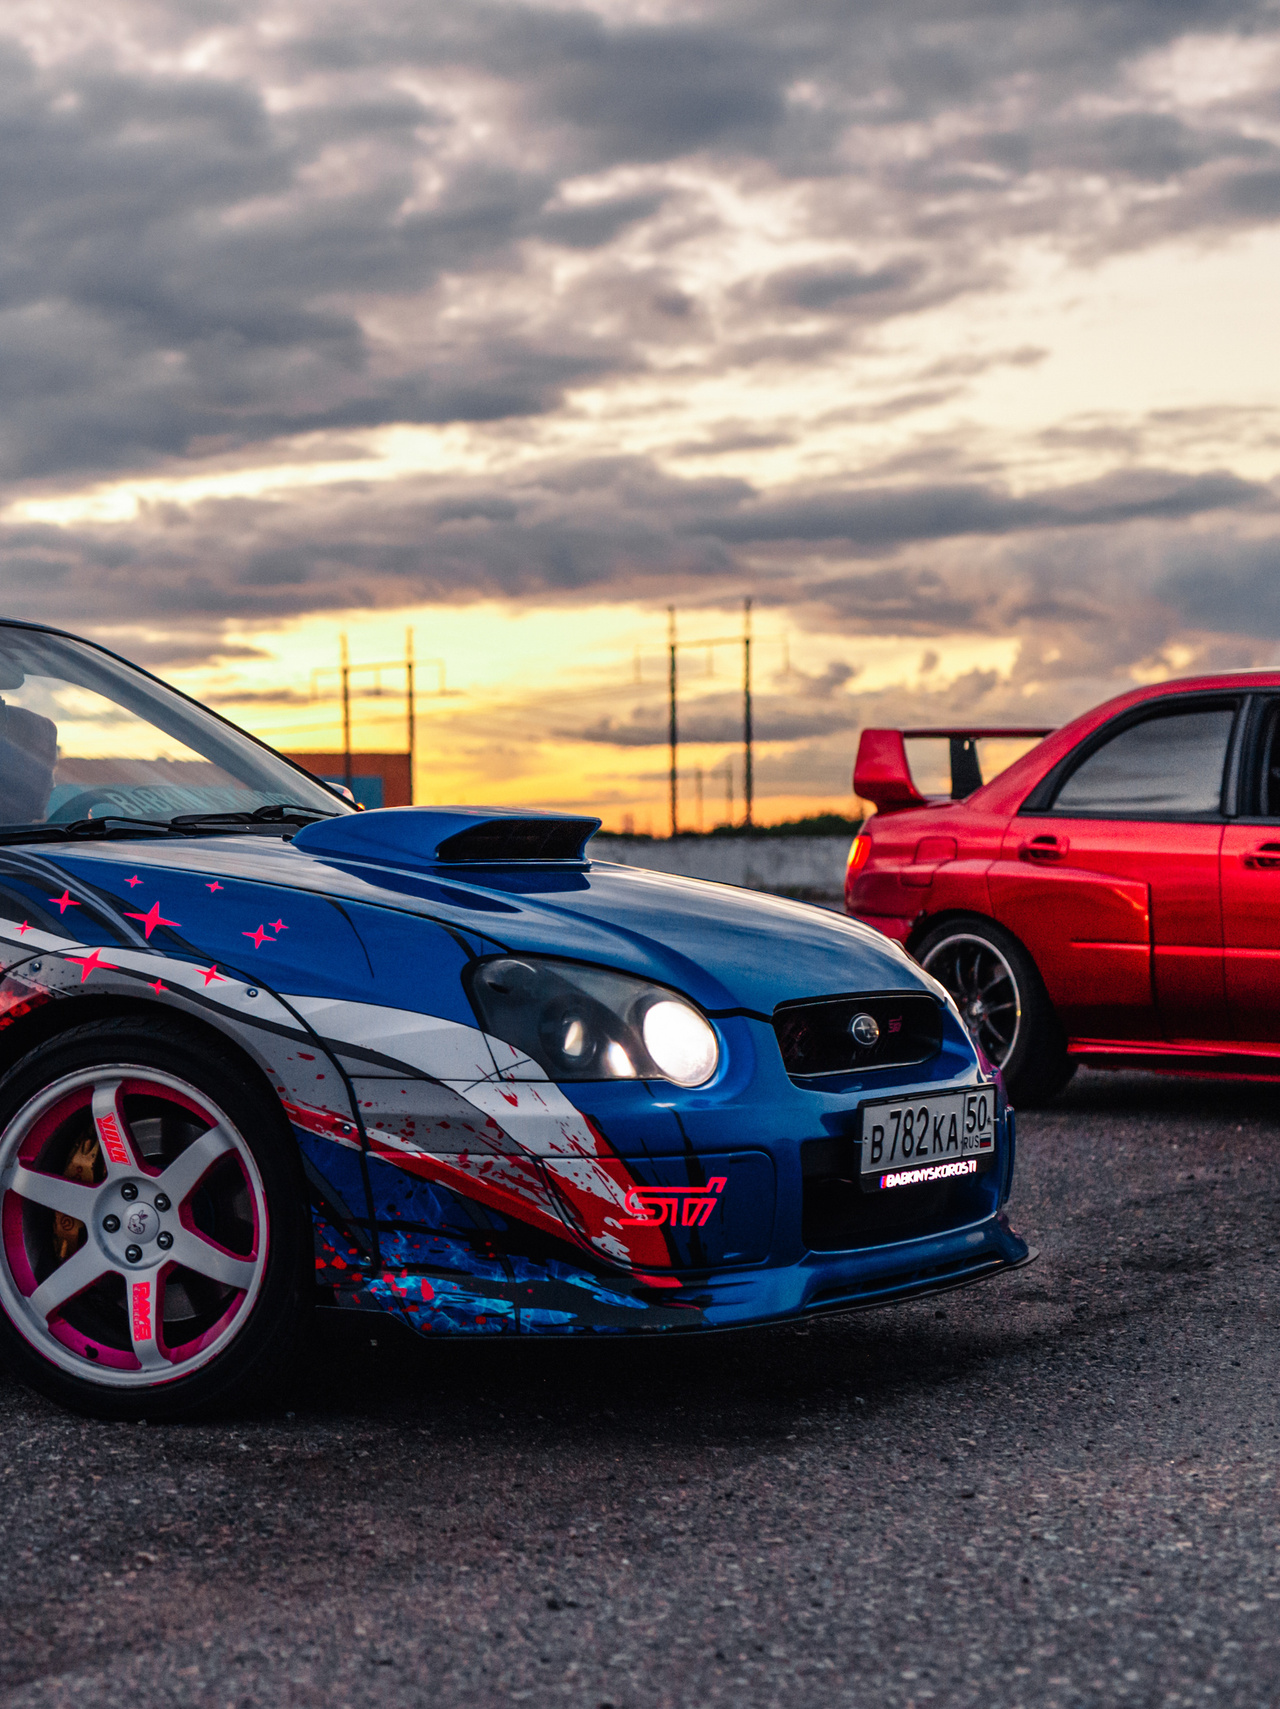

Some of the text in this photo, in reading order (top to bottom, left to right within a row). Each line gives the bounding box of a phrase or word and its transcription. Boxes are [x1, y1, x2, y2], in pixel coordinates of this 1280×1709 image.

[965, 1094, 987, 1133] 50
[963, 1134, 980, 1149] RUS
[885, 1159, 977, 1188] BABKINYSKOROSTI
